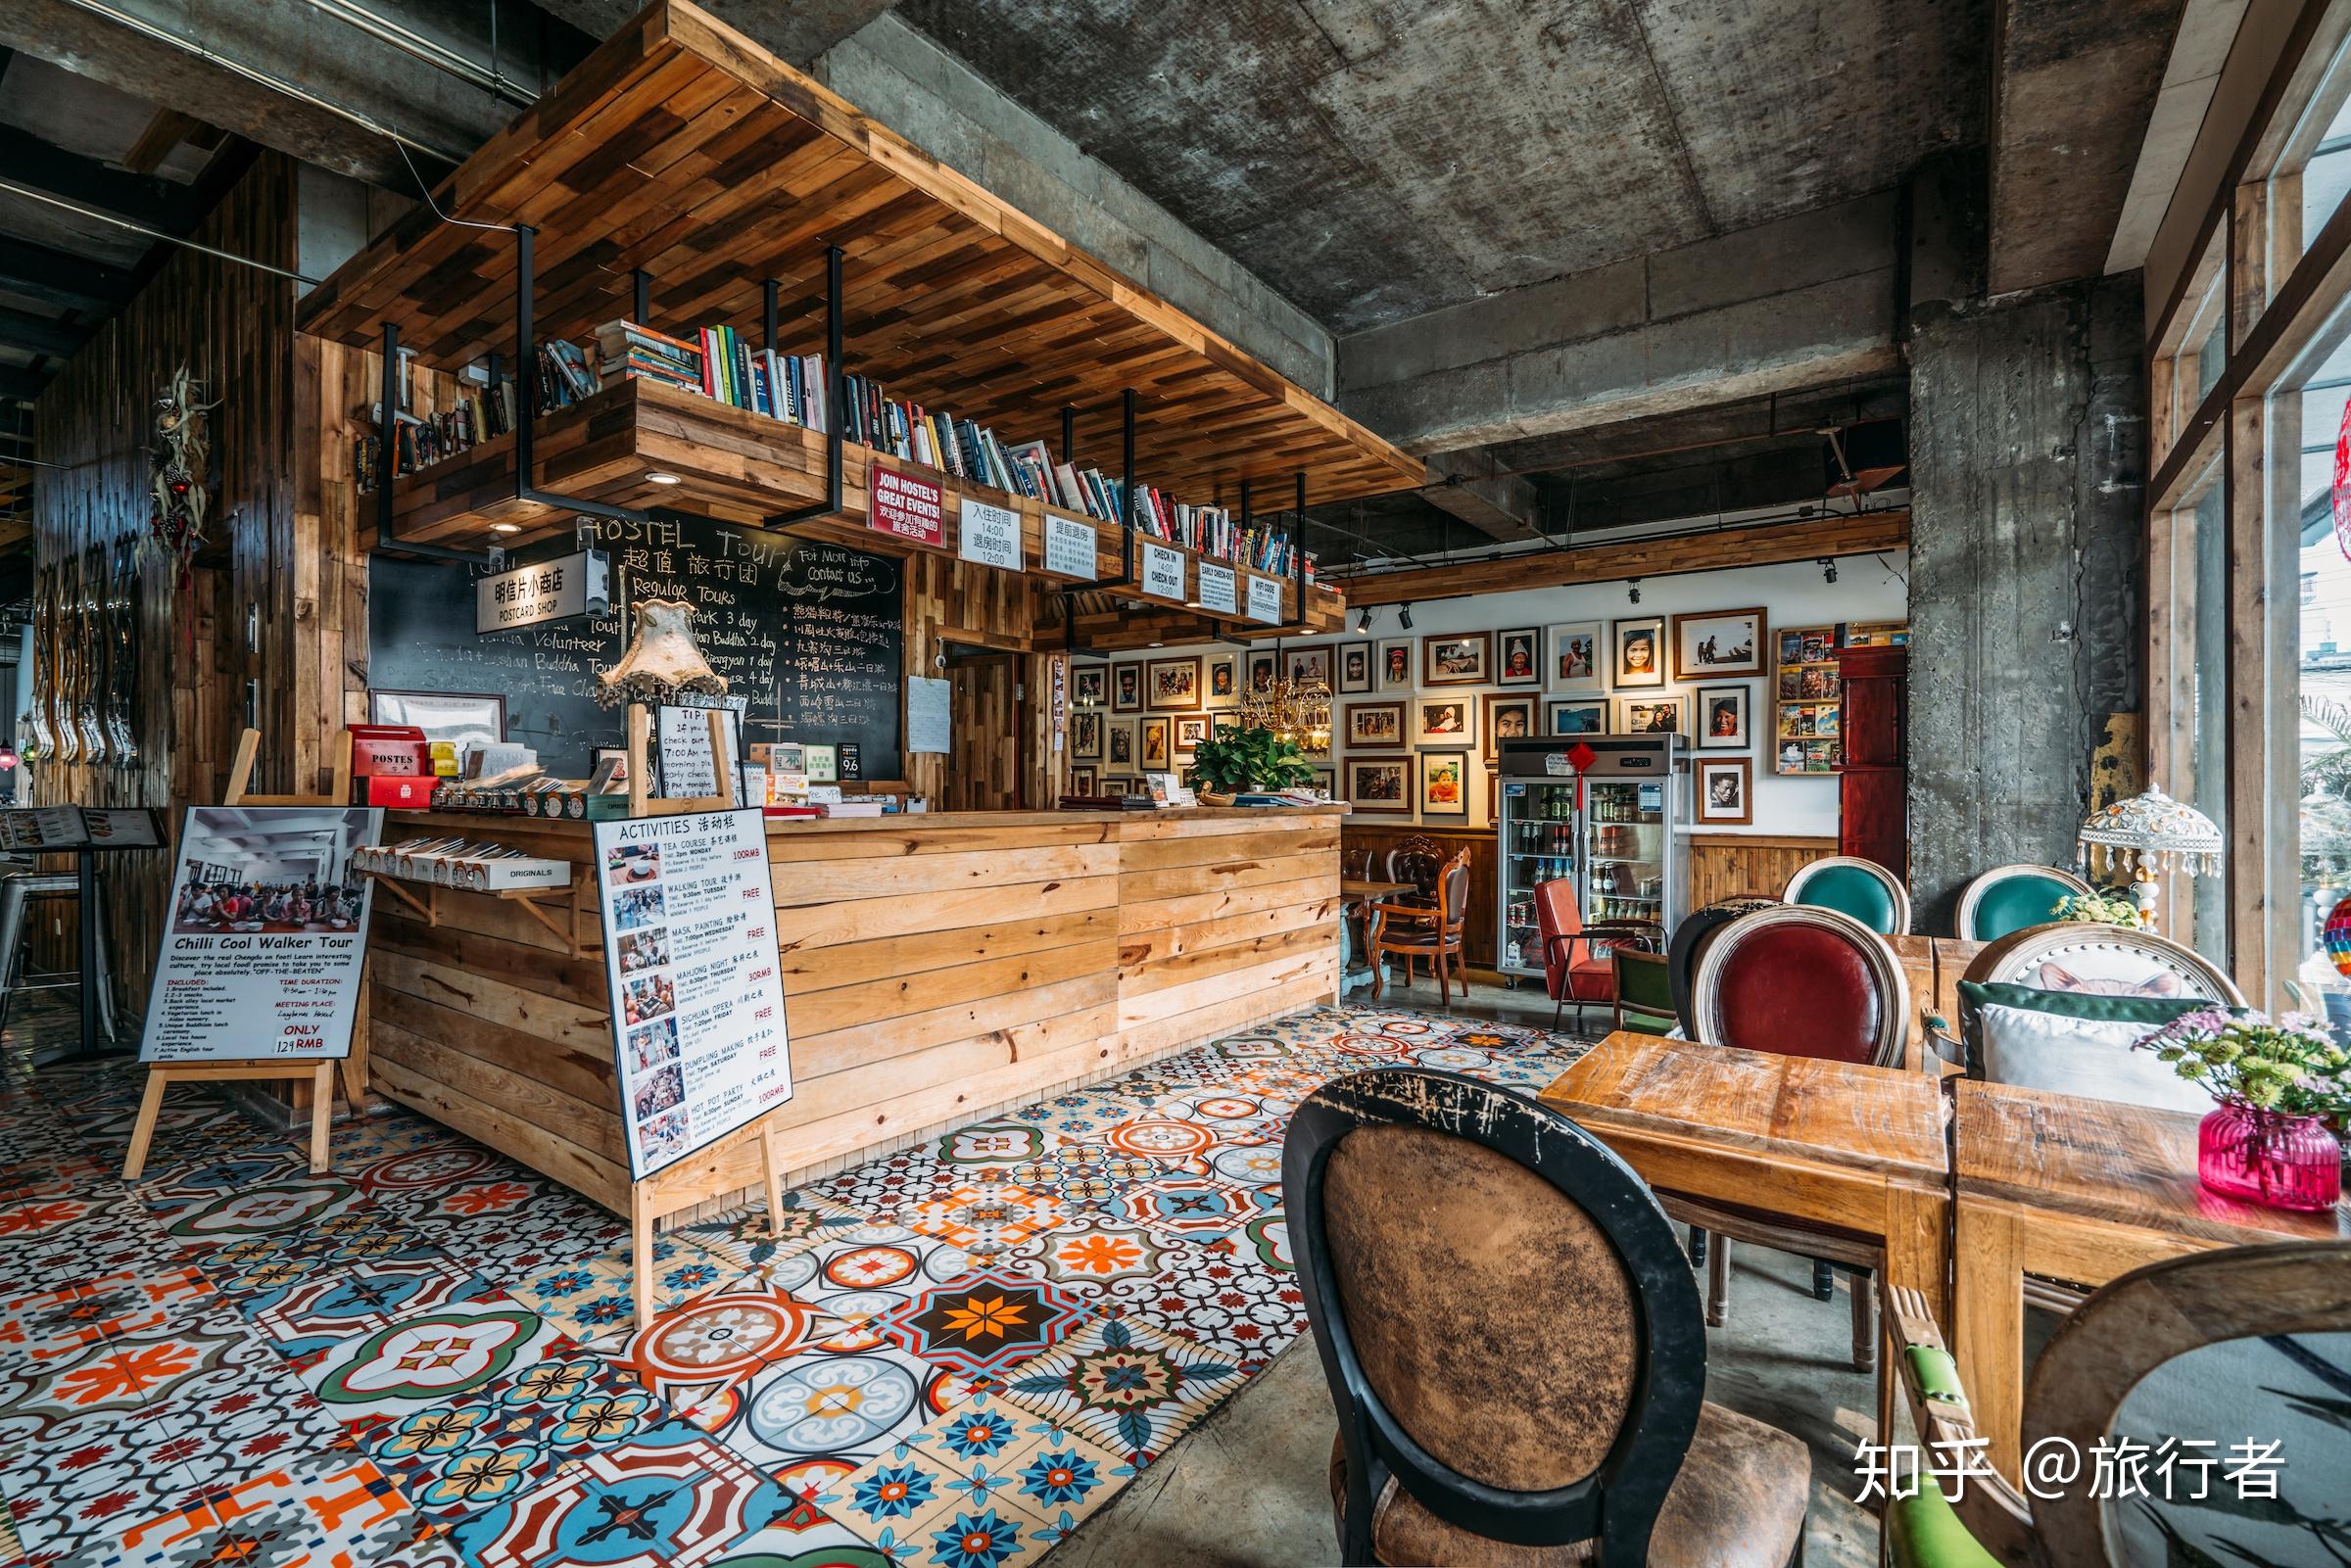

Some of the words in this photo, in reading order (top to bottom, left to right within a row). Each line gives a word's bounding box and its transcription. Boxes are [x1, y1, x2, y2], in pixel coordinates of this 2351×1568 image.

[880, 472, 898, 491] JOIN
[900, 477, 938, 502] HOSTEL'S
[877, 489, 905, 509] GREAT
[906, 498, 940, 520] EVENTS!
[880, 504, 938, 532] 欢迎参加有趣的
[973, 504, 1011, 527] 入住时间
[578, 520, 696, 549] HOSTEL
[892, 520, 926, 540] 旅舍活动
[982, 523, 1004, 537] 14:00
[1056, 520, 1088, 542] 提前退房
[973, 533, 1012, 554] 退房时间
[798, 548, 817, 562] For
[822, 549, 846, 563] More
[983, 550, 1004, 565] 12:00
[1154, 547, 1171, 562] CHECK
[1171, 551, 1176, 562] IN
[807, 566, 843, 583] Contact
[1157, 561, 1174, 573] 14:00
[1202, 565, 1214, 576] EARLY
[495, 566, 563, 604] 明信片小商店
[1151, 571, 1168, 585] CHECK
[1169, 576, 1178, 587] OUT
[1156, 585, 1174, 595] 12:00
[500, 604, 535, 623] POSTCARD
[538, 599, 557, 616] SHOP
[727, 611, 735, 624] 3
[739, 612, 757, 635] day
[534, 634, 606, 653] Volunteer
[713, 631, 746, 646] Buddha
[750, 637, 759, 646] 2
[760, 633, 776, 656] day
[535, 652, 580, 673] Buddha
[758, 653, 774, 675] day
[749, 671, 757, 685] 4
[759, 670, 774, 691] day
[682, 710, 705, 720] TIP:
[372, 754, 413, 764] POSTES
[841, 759, 858, 772] 9.6
[618, 820, 690, 840] ACTIVITIES
[697, 814, 736, 832] 活动栏
[664, 842, 677, 851] TEA
[681, 838, 706, 848] COURSE
[733, 848, 760, 861] 100RMB
[509, 869, 552, 878] ORIGINALS
[668, 880, 697, 893] WALKING
[701, 878, 717, 887] TOUR
[683, 890, 702, 899] 9:30am
[704, 885, 727, 895] TUESDAY
[743, 887, 760, 900] FREE
[672, 925, 692, 937] MASK
[695, 918, 723, 931] PAINTING
[685, 932, 703, 942] 7:00pm
[704, 925, 735, 937] WEDNESDAY
[746, 927, 765, 940] FREE
[174, 938, 214, 949] Chilli
[219, 937, 252, 948] Cool
[258, 936, 313, 948] Walker
[317, 936, 354, 948] Tour
[677, 964, 707, 981] MAHJONG
[710, 958, 729, 971] NIGHT
[689, 974, 708, 985] 6:30pm
[710, 965, 737, 978] THURSDAY
[748, 967, 772, 982] 30RMB
[681, 1007, 709, 1024] SICHUAN
[712, 999, 733, 1014] OPERA
[714, 1009, 733, 1021] FRIDAY
[754, 1006, 772, 1022] FREE
[284, 1024, 320, 1035] ONLY
[277, 1041, 295, 1052] 129
[296, 1038, 324, 1048] RMB
[721, 1038, 744, 1055] MAKING
[759, 1045, 777, 1061] FREE
[710, 1051, 738, 1068] SATURDAY
[692, 1102, 703, 1115] HOT
[707, 1094, 720, 1107] POT
[724, 1083, 744, 1099] PARTY
[724, 1093, 744, 1108] SUNDAY
[758, 1083, 785, 1105] 100RMB
